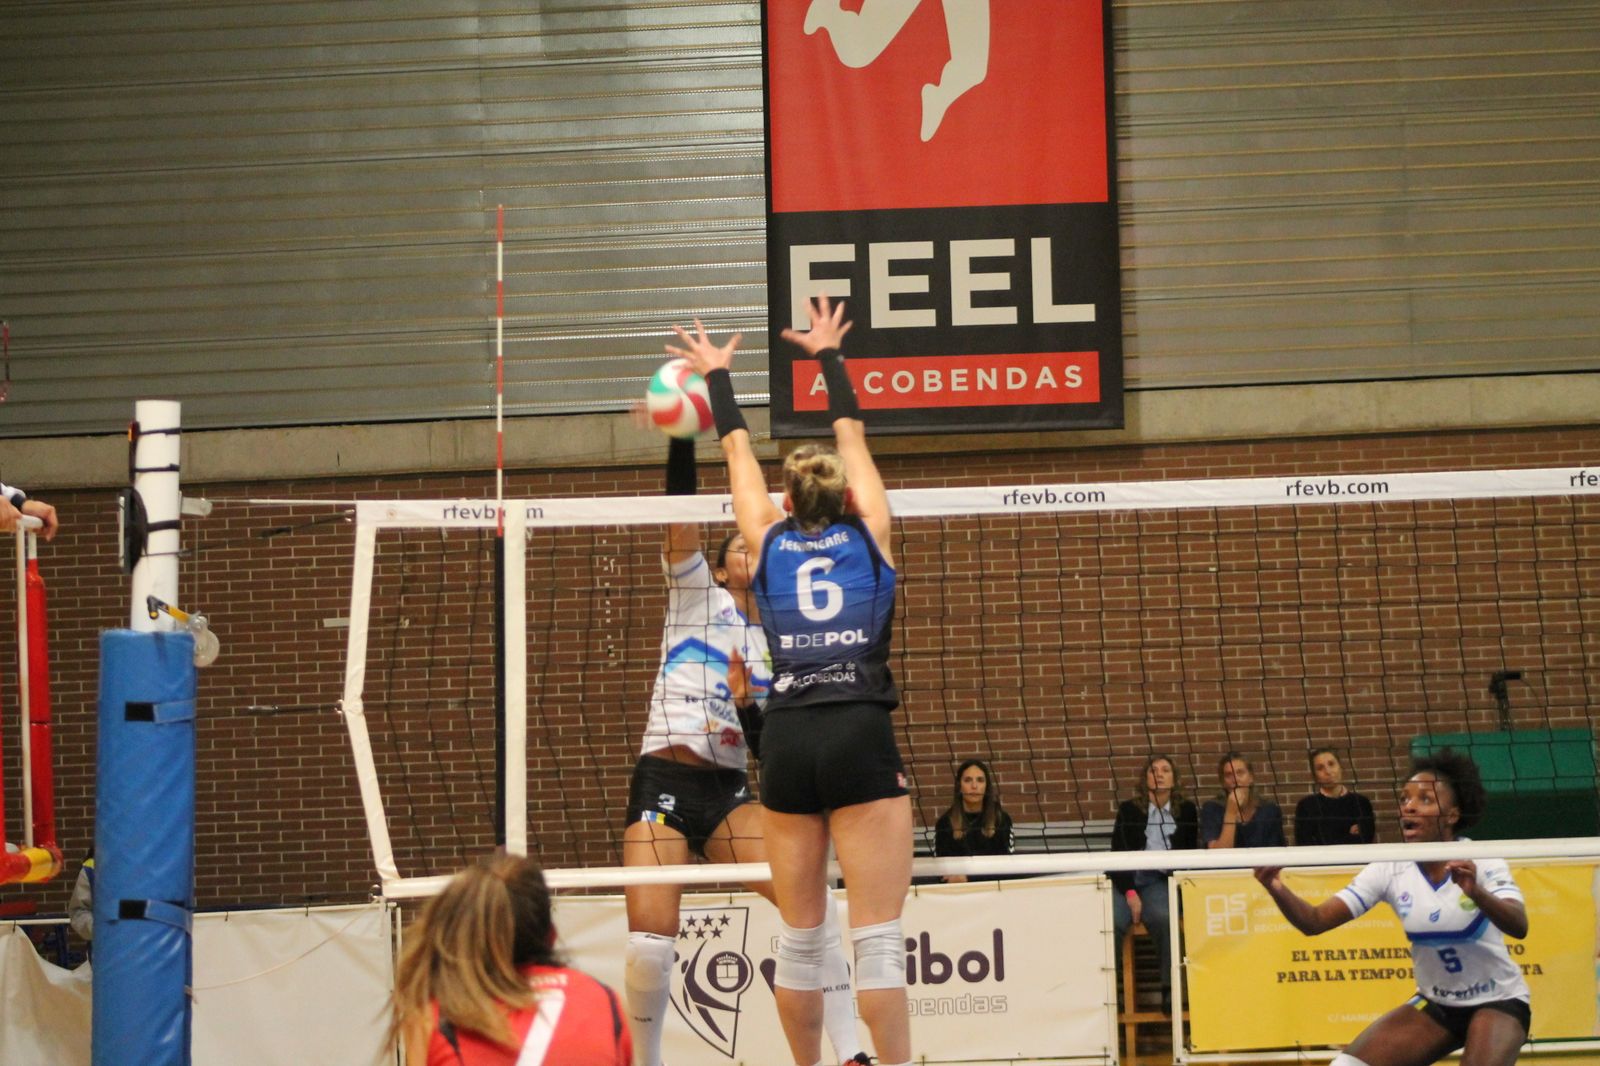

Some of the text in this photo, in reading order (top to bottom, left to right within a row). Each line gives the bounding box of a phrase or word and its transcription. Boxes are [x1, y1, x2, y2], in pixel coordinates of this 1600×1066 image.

[790, 237, 1096, 331] FEEL
[809, 365, 1083, 396] ACOBENDAS
[1003, 488, 1106, 506] rfevb.com
[1286, 480, 1389, 497] rfevb.com
[443, 504, 544, 520] rfevbm
[797, 556, 844, 622] 6
[796, 628, 869, 648] DEPOL
[1292, 948, 1412, 962] EL TRATAMIEN
[1437, 947, 1463, 974] 5
[1277, 971, 1321, 983] PARA
[1325, 970, 1345, 982] LA
